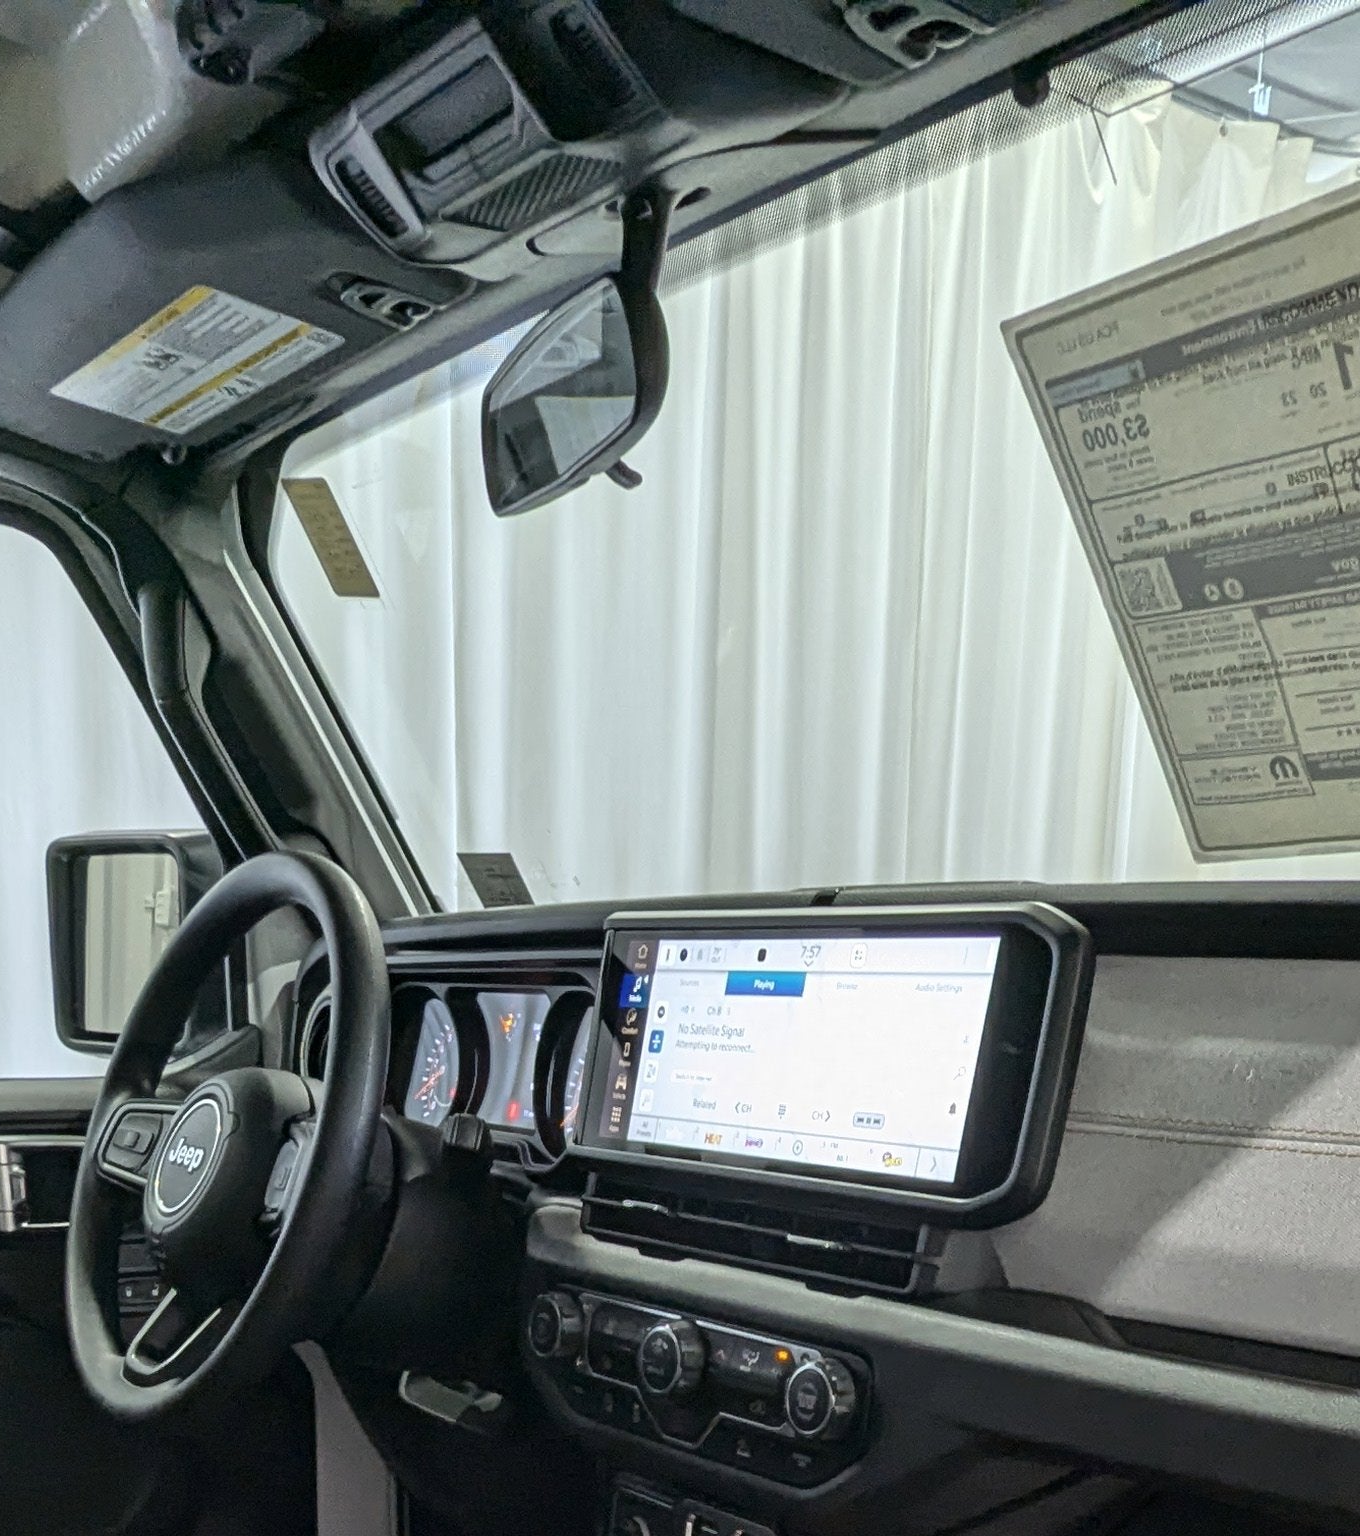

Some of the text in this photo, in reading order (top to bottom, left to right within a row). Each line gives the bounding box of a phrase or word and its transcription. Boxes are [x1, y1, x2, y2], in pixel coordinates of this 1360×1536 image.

[801, 946, 821, 959] 7:57
[753, 979, 775, 991] Playing
[915, 984, 963, 994] Audio Settings
[678, 1023, 745, 1039] No Satellite Signal
[675, 1039, 710, 1053] Attempting
[741, 1103, 752, 1113] CH
[812, 1110, 824, 1120] CH
[704, 1133, 723, 1145] HEAT
[168, 1138, 204, 1172] Jeep
